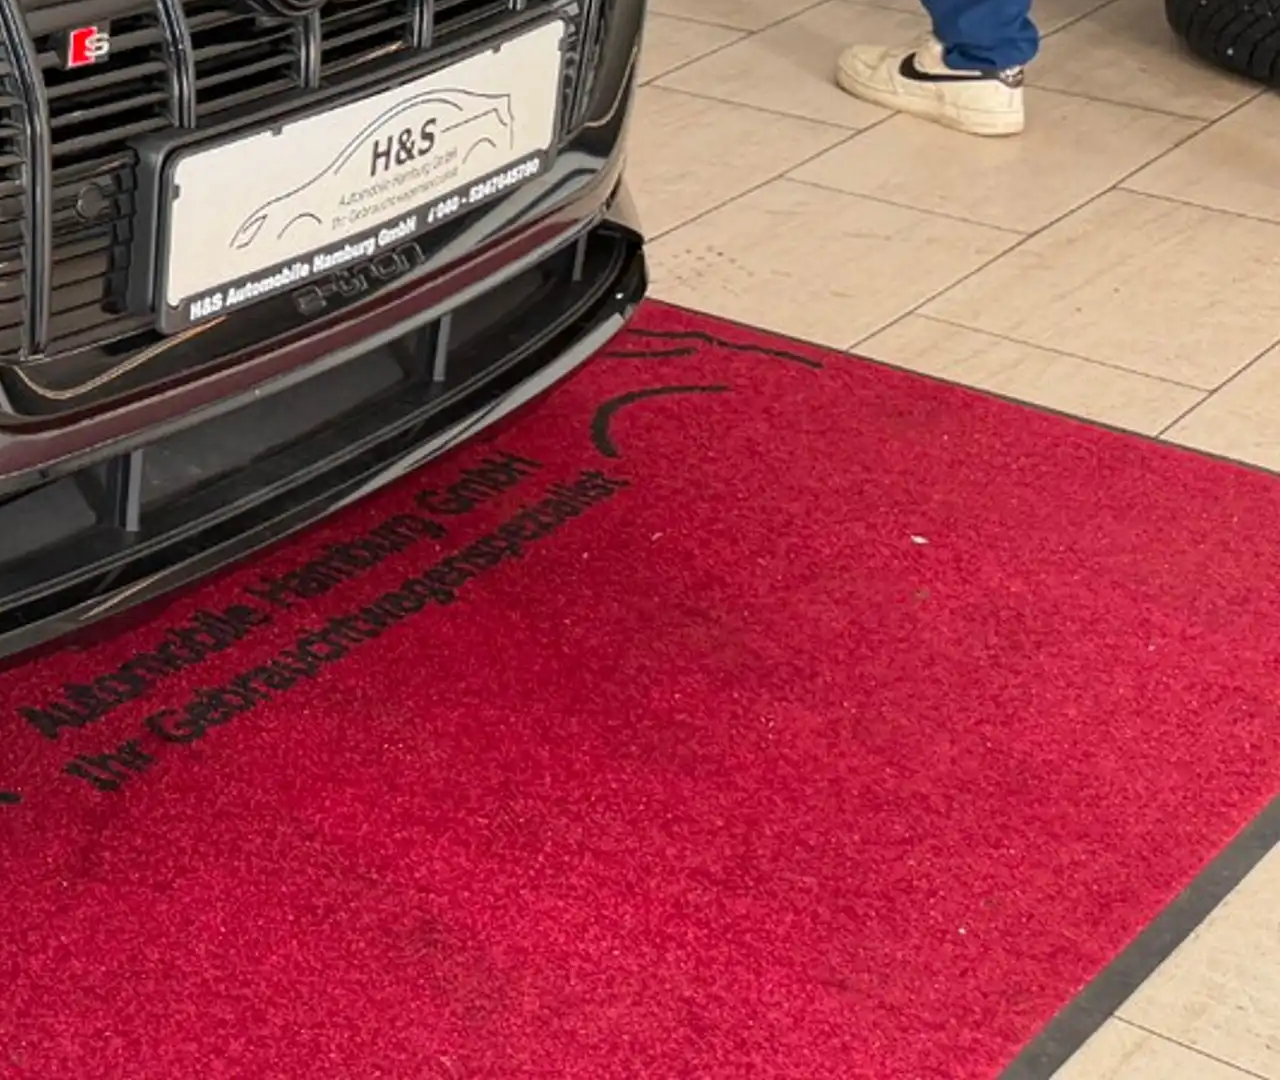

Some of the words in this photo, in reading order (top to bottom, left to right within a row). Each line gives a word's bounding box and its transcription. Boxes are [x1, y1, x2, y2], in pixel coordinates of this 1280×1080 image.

[370, 117, 438, 178] H&S
[189, 291, 224, 321] H&S
[226, 261, 311, 307] Automobile
[312, 234, 377, 273] Hamburg
[377, 215, 418, 247] GmbH
[292, 240, 427, 317] e-tron
[20, 604, 273, 741] Automobile
[245, 514, 448, 608] Hamburg
[415, 450, 545, 516] GmbH
[61, 739, 157, 793] Ihr
[142, 469, 634, 744] Gebrauchtwagenspezialist
